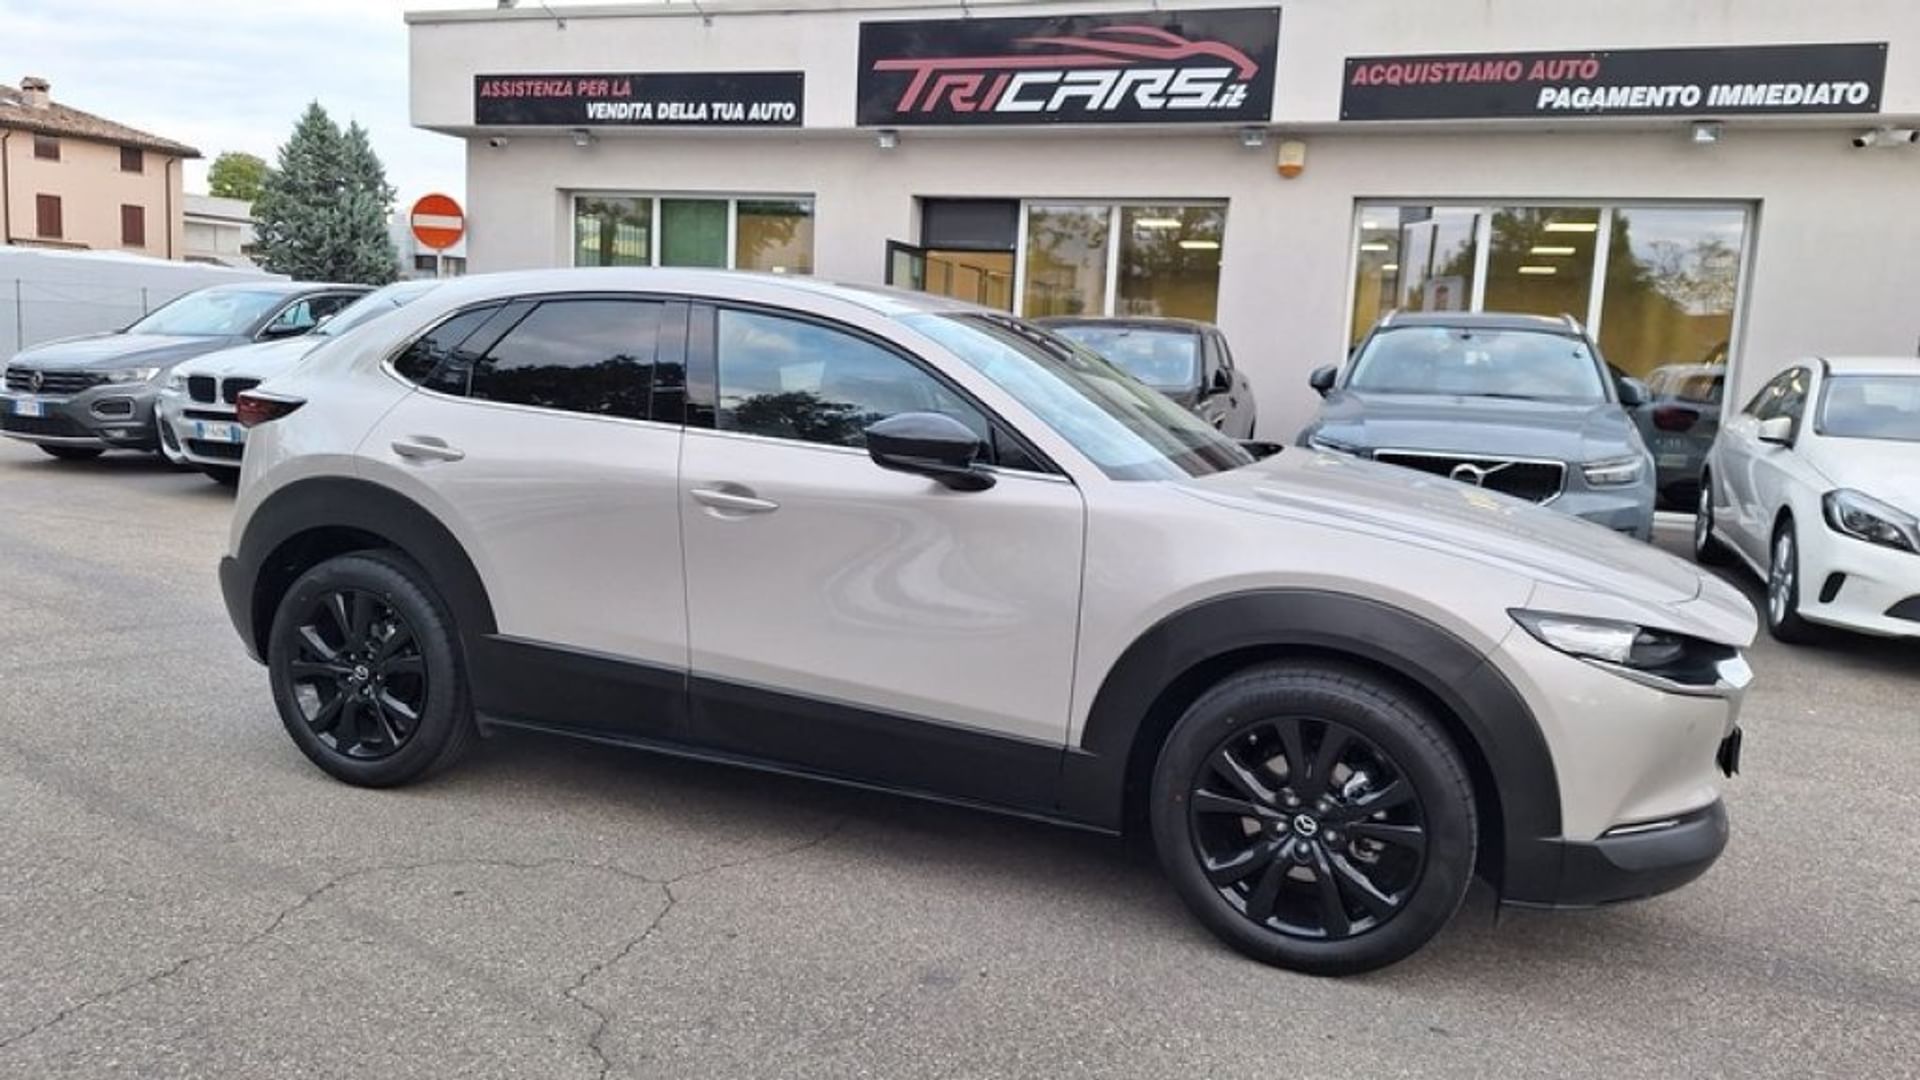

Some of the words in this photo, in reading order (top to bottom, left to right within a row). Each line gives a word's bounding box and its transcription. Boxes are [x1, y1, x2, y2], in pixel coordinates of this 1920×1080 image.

[873, 54, 1248, 112] TRICARS.it
[1352, 63, 1523, 86] ACQUISTIAMO
[1528, 59, 1600, 81] AUTO
[480, 81, 573, 97] ASSISTENZA
[578, 79, 609, 95] PER
[612, 79, 632, 95] LA
[1537, 86, 1700, 109] PAGAMENTO
[1707, 82, 1869, 106] IMMEDIATO
[587, 102, 653, 119] VENDITA
[657, 102, 707, 120] DELLA
[711, 102, 744, 120] TUA
[748, 102, 796, 120] AUTO
